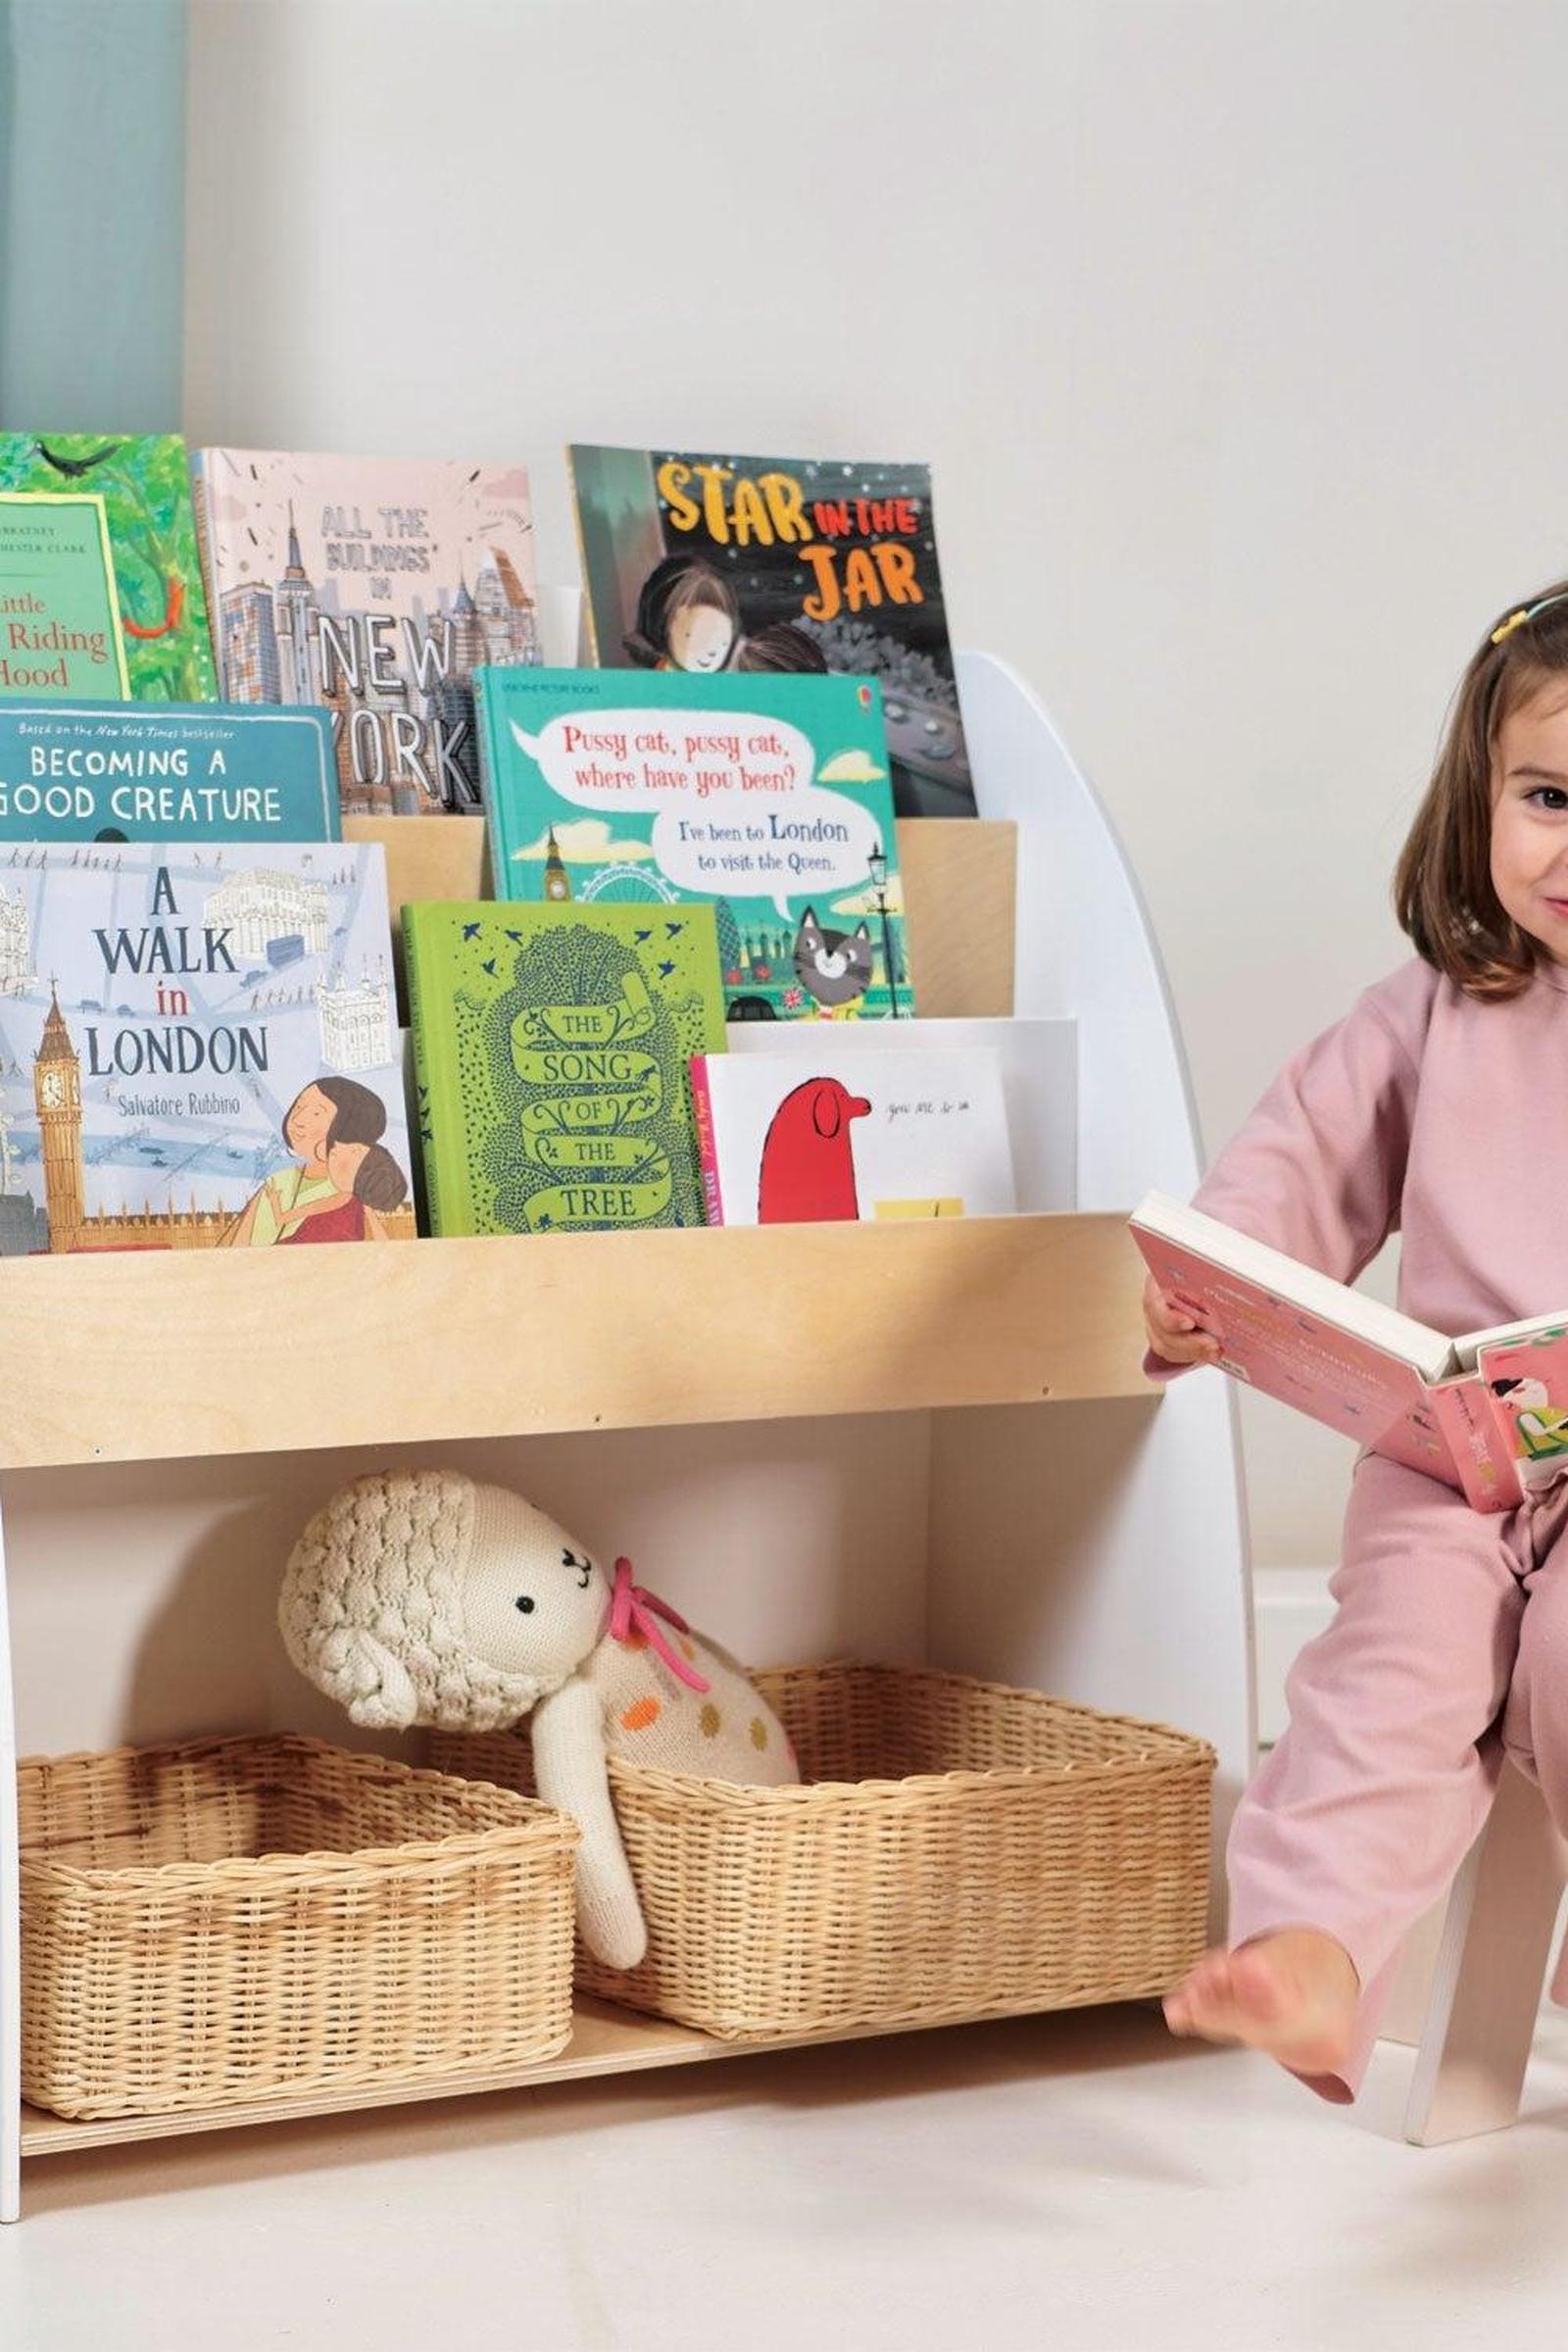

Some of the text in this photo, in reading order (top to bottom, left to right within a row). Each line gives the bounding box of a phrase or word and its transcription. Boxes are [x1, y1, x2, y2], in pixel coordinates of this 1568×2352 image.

[657, 462, 919, 546] STAR IN THE
[321, 505, 429, 540] ALL THE
[798, 541, 924, 621] JAR
[0, 593, 46, 614] ittle
[8, 620, 109, 664] Riding
[318, 614, 457, 699] NEW
[18, 722, 51, 735] Based
[56, 725, 71, 735] on
[74, 724, 92, 736] the
[96, 725, 118, 737] New
[563, 725, 790, 762] Pussy cat, pussy cat,
[31, 746, 226, 776] BECOMING A
[330, 708, 479, 808] ORK
[575, 761, 795, 798] where have you been?
[111, 786, 281, 821] CREATURE
[678, 814, 849, 843] I've been to London
[698, 854, 836, 875] to visit the Queen.
[151, 866, 180, 915] A
[91, 926, 240, 974] WALK
[157, 980, 189, 1015] in
[562, 1015, 602, 1033] THE
[84, 1026, 269, 1076] LONDON
[544, 1054, 631, 1081] SONG
[119, 1093, 241, 1116] Salvatore Rubbino
[575, 1101, 601, 1121] OF
[574, 1143, 616, 1161] THE
[560, 1189, 636, 1217] TREE
